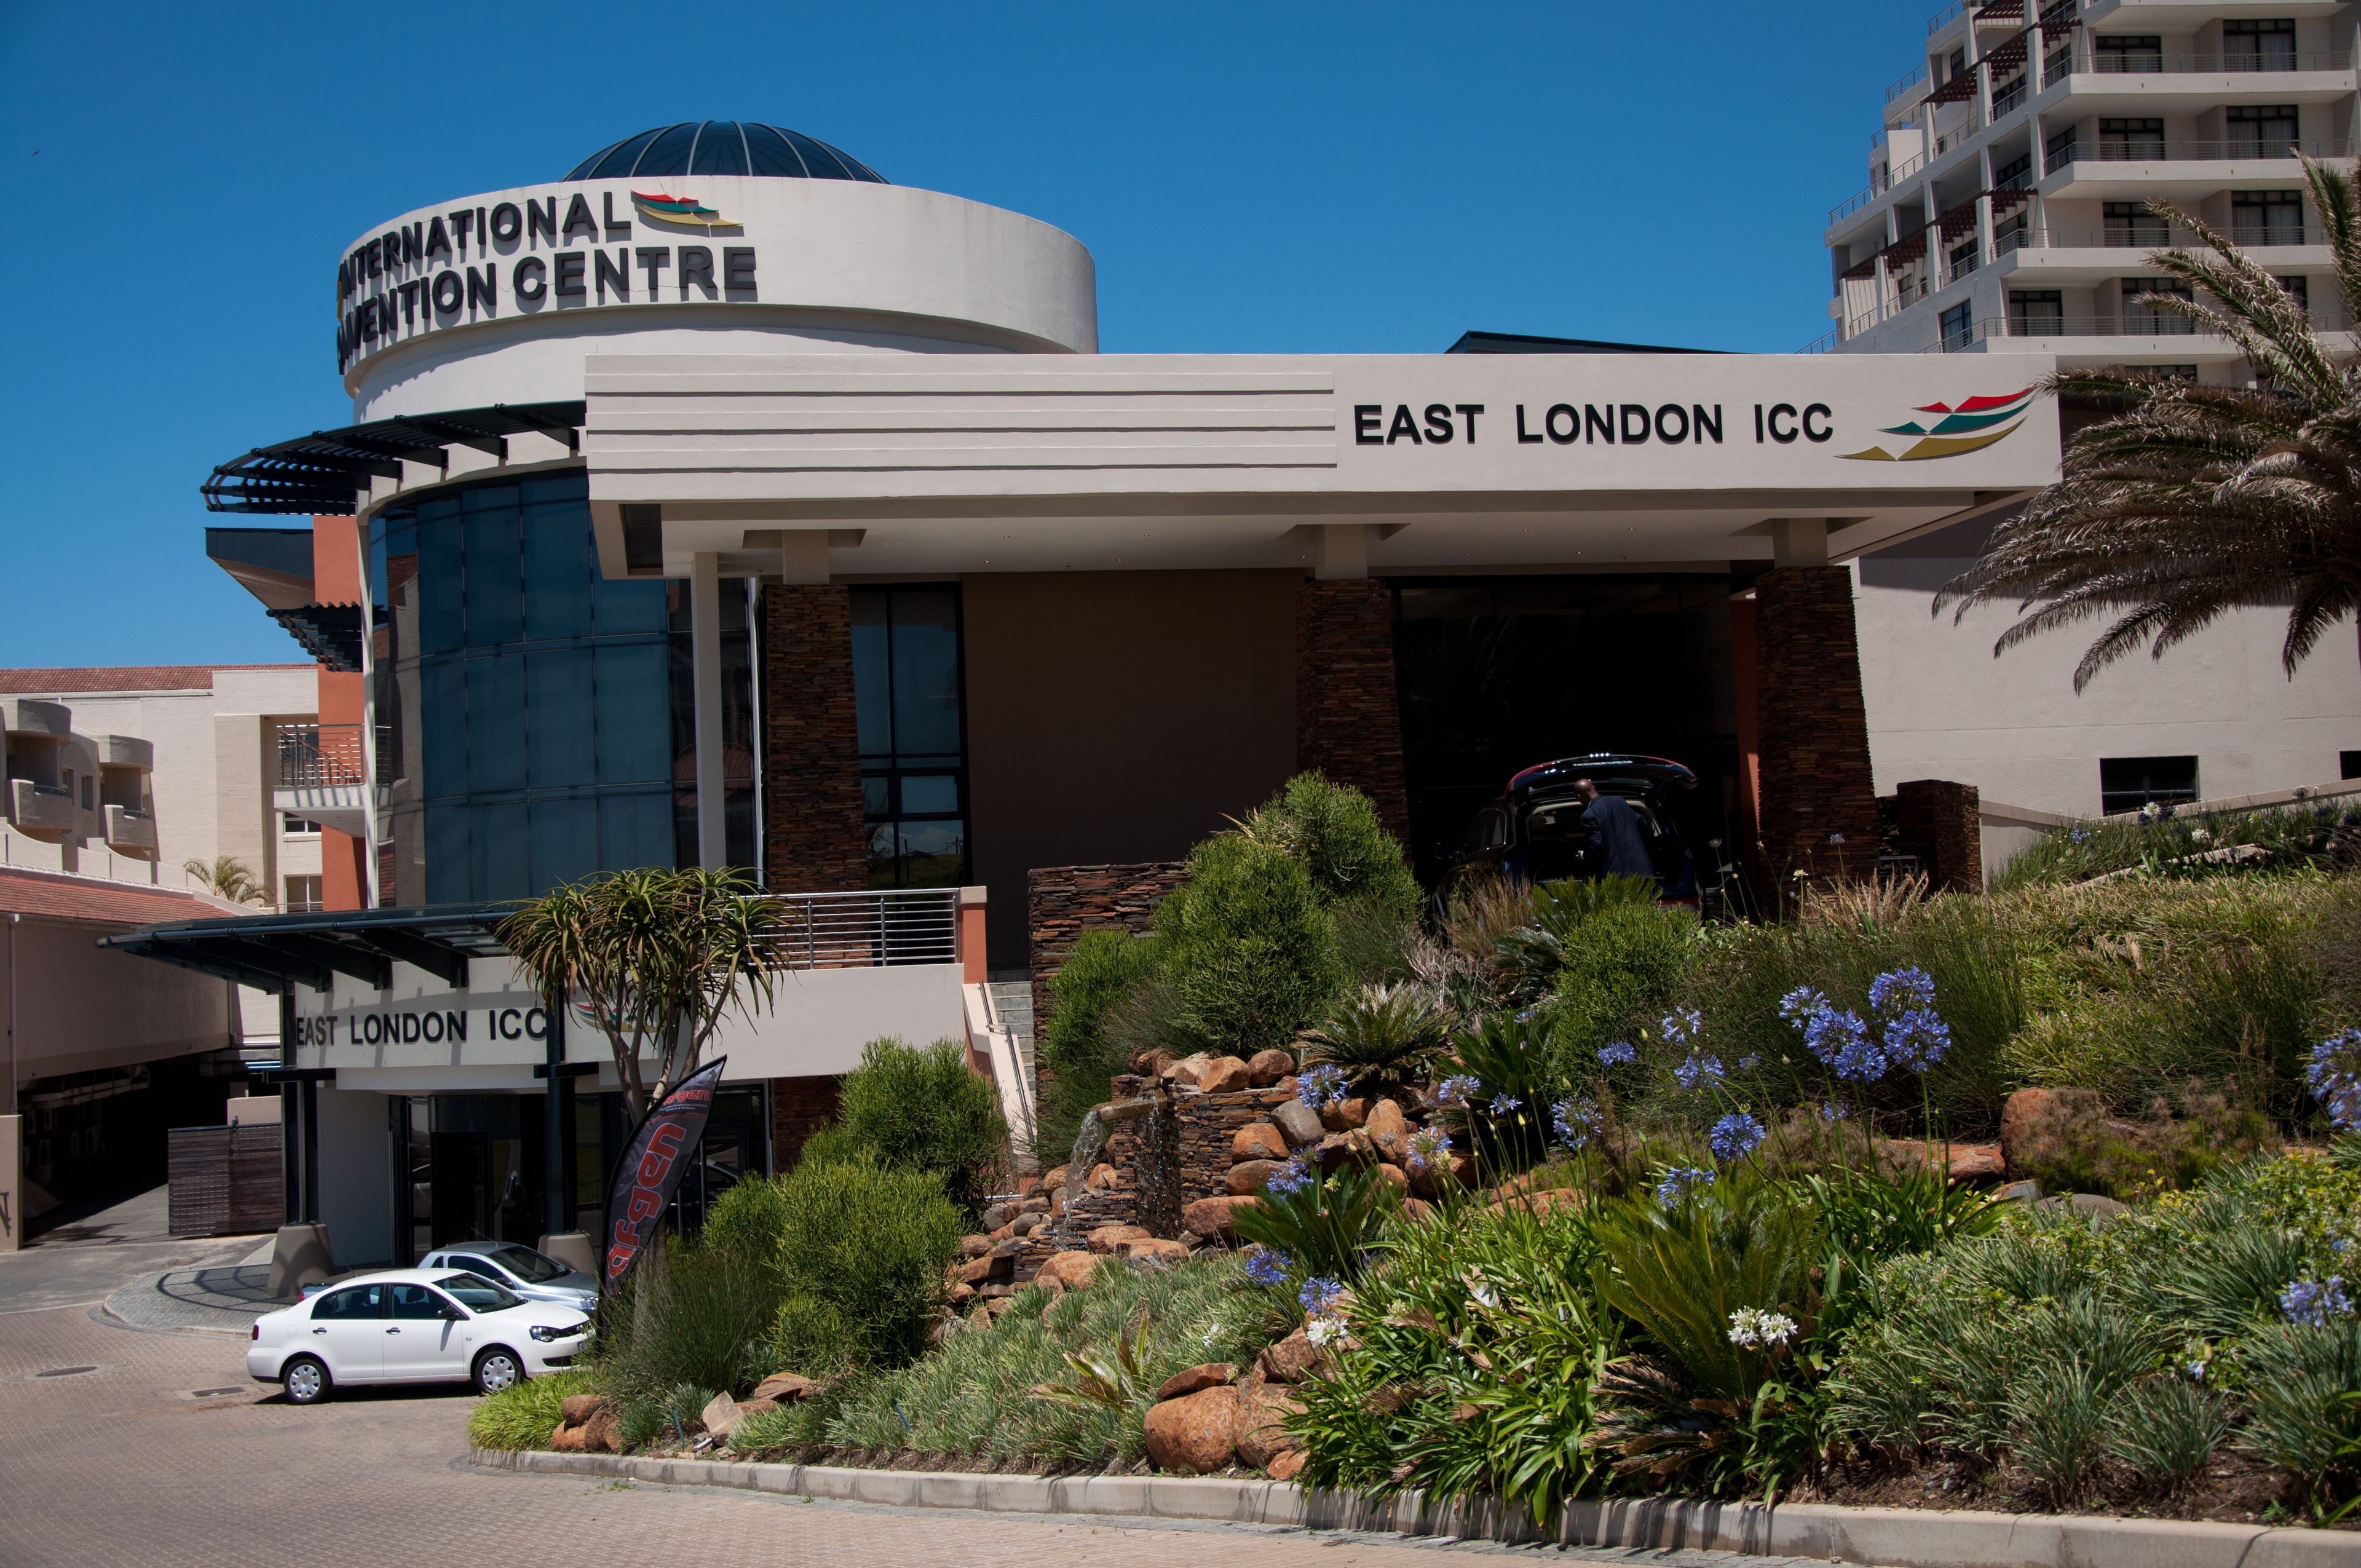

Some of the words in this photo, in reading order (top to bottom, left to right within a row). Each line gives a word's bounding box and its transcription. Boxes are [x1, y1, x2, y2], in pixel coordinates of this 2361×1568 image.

[513, 246, 757, 300] CENTRE
[1354, 403, 1485, 445] EAST
[1516, 403, 1723, 445] LONDON
[1754, 403, 1833, 444] ICC
[296, 1016, 338, 1047] EAST
[350, 1010, 468, 1045] LONDON
[489, 1007, 547, 1040] ICC
[607, 1122, 687, 1278] afgen
